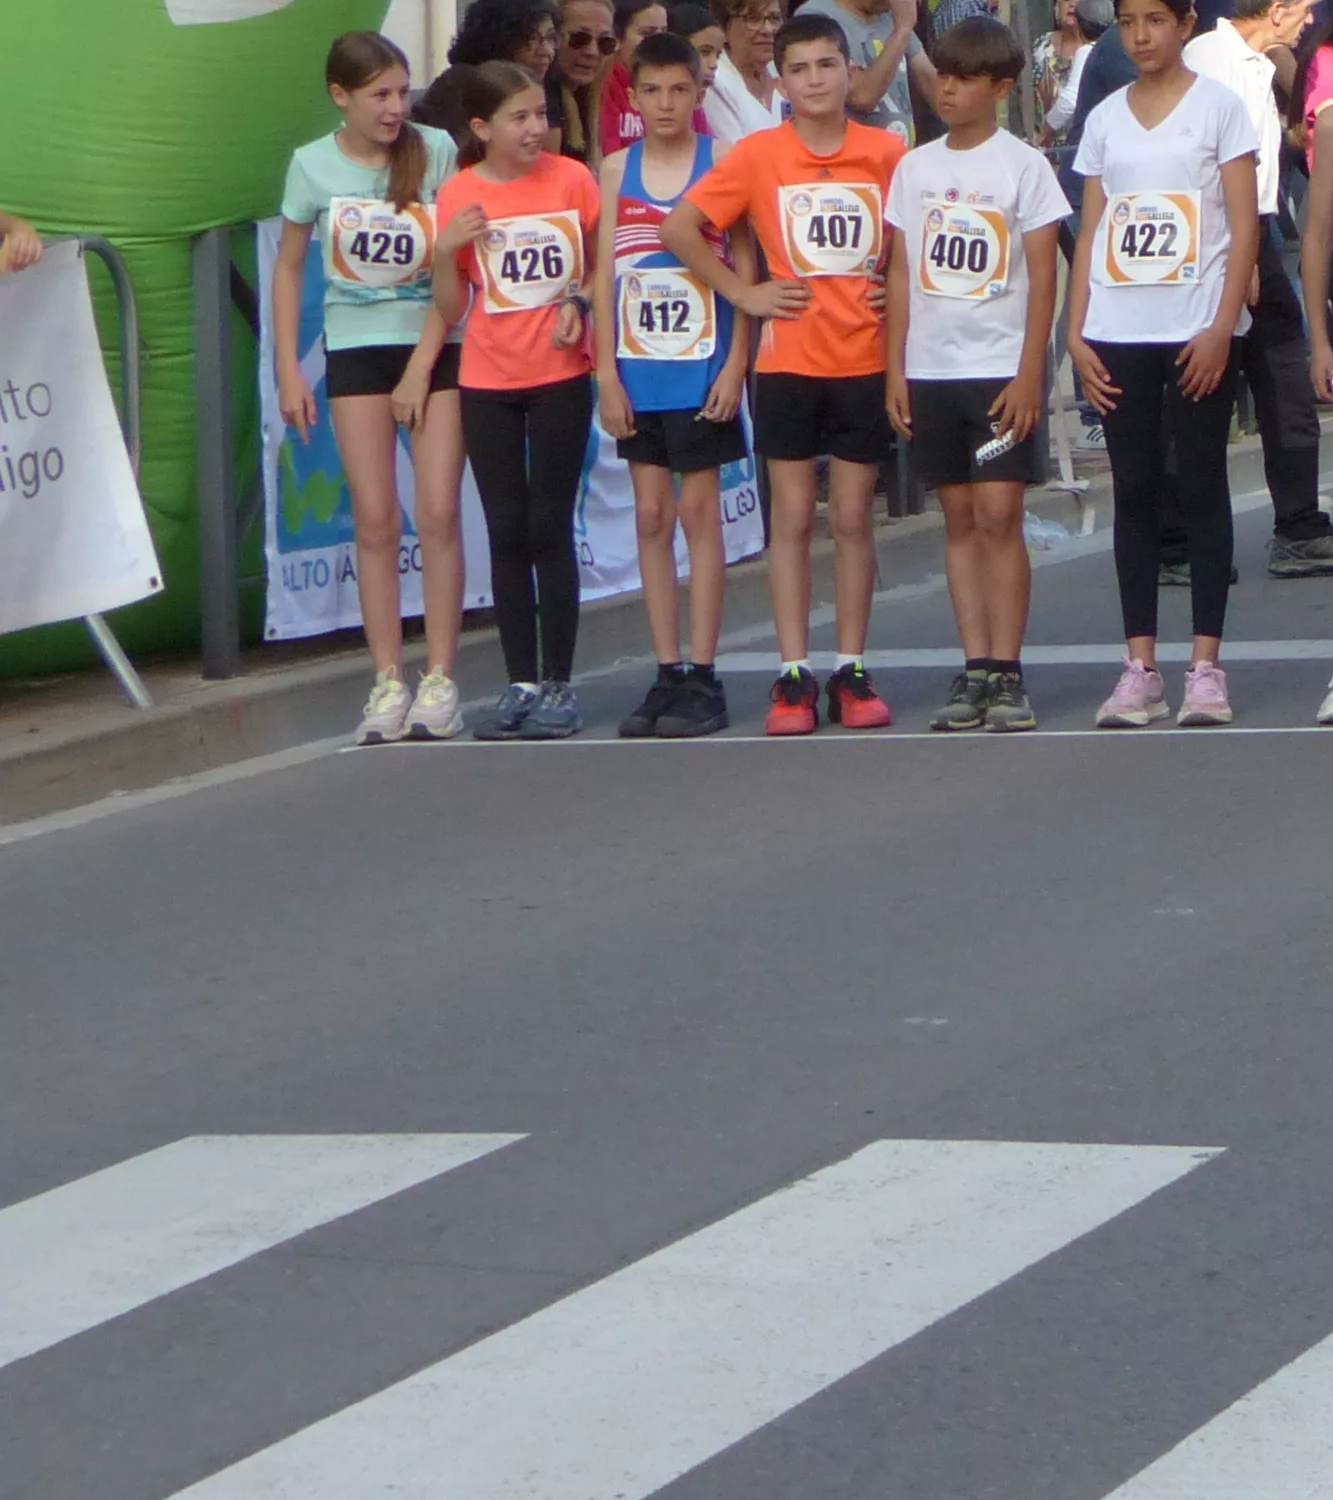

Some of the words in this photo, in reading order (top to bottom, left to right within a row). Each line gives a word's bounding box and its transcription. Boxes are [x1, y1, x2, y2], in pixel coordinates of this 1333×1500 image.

[349, 231, 414, 265] 429
[807, 214, 863, 249] 407
[1120, 222, 1178, 258] 422
[501, 244, 564, 284] 426
[930, 233, 989, 273] 400
[639, 300, 690, 333] 412
